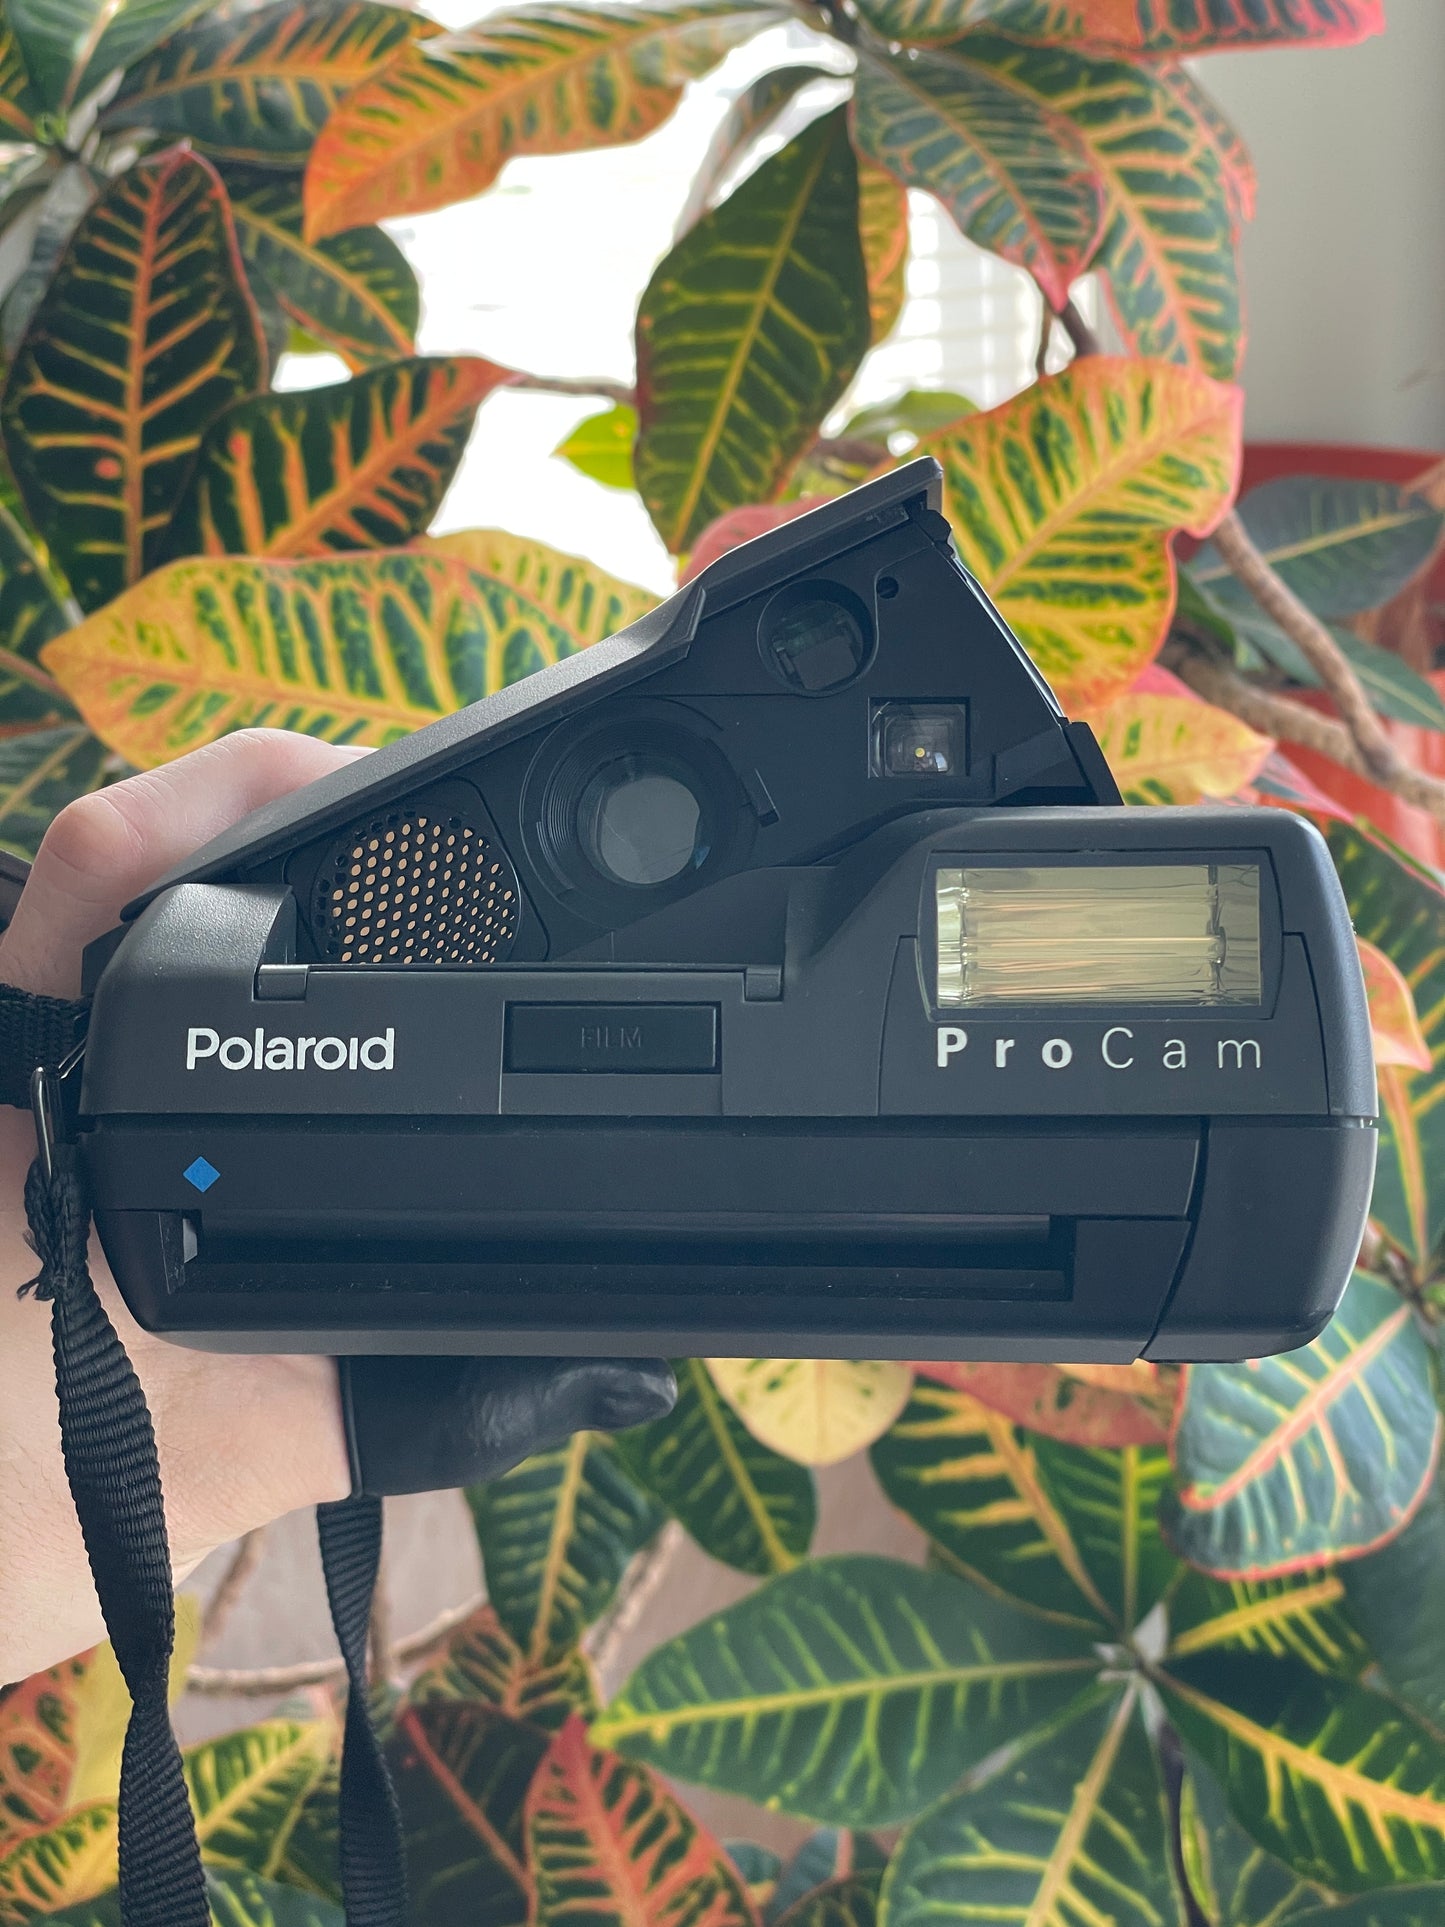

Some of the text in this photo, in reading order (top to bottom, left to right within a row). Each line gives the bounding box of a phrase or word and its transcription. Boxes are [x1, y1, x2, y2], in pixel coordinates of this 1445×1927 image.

[186, 1027, 395, 1071] Polaroid
[580, 1026, 643, 1049] FILM
[936, 1026, 1262, 1069] ProCam
